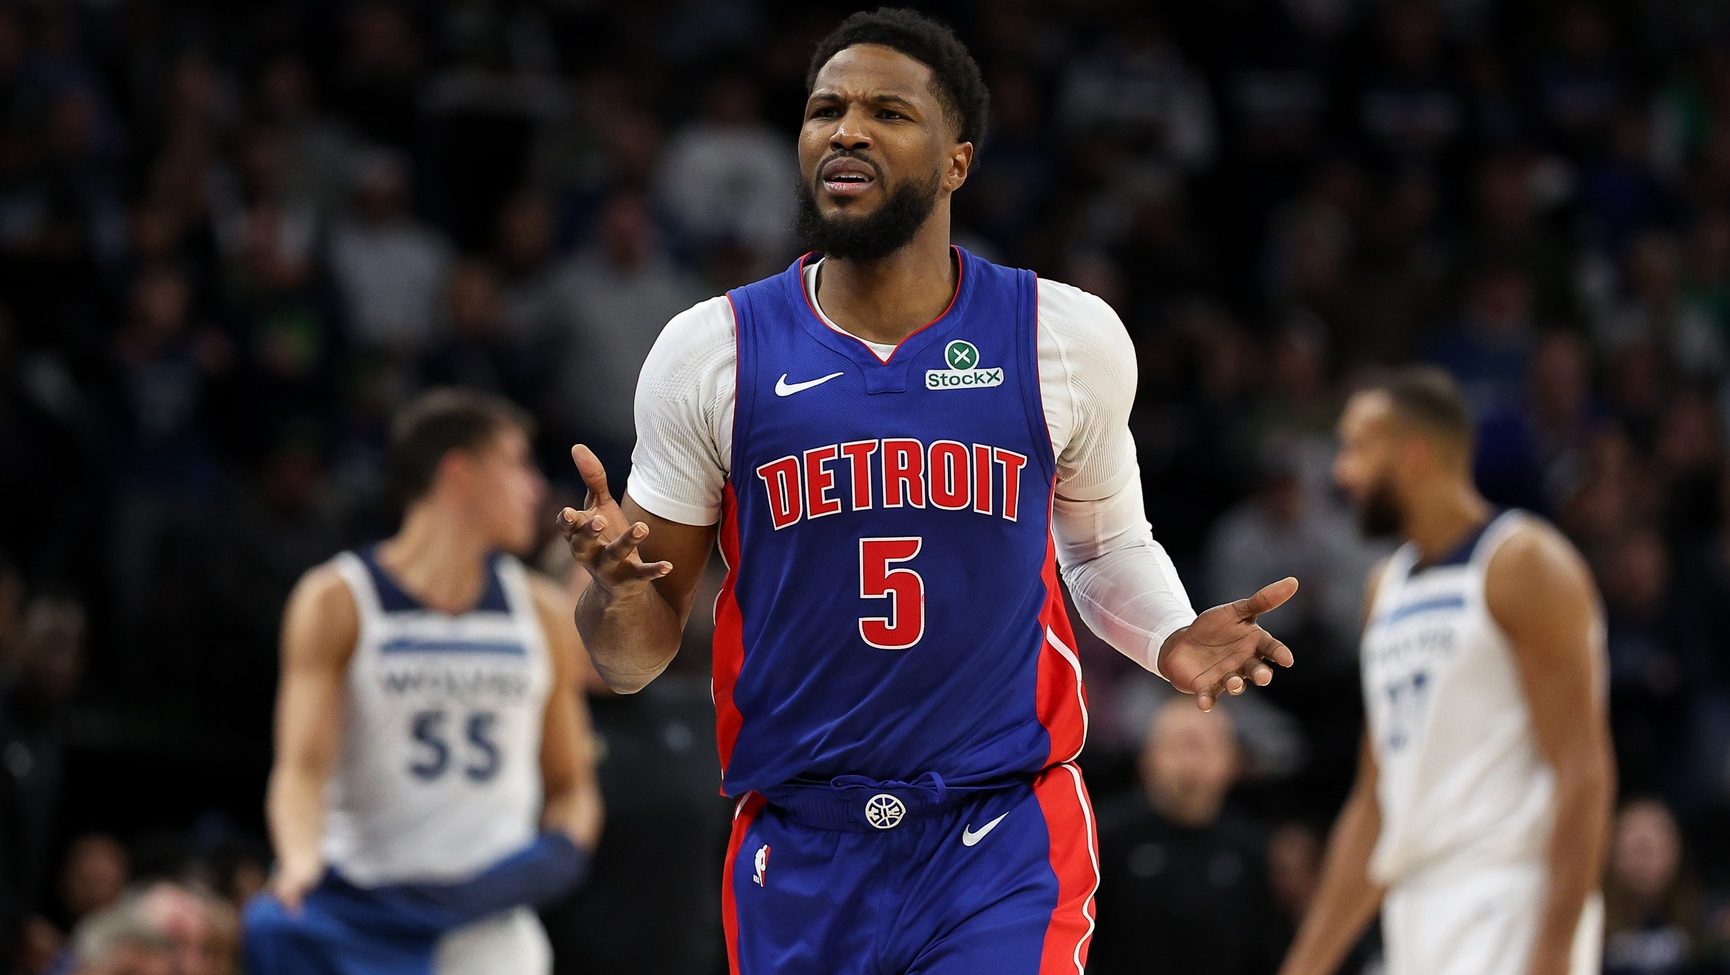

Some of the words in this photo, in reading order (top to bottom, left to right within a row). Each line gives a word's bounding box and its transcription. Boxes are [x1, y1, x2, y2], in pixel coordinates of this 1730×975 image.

[928, 369, 1001, 387] StockX
[756, 438, 1027, 530] DETROIT
[858, 536, 925, 649] 5
[409, 709, 502, 783] 55
